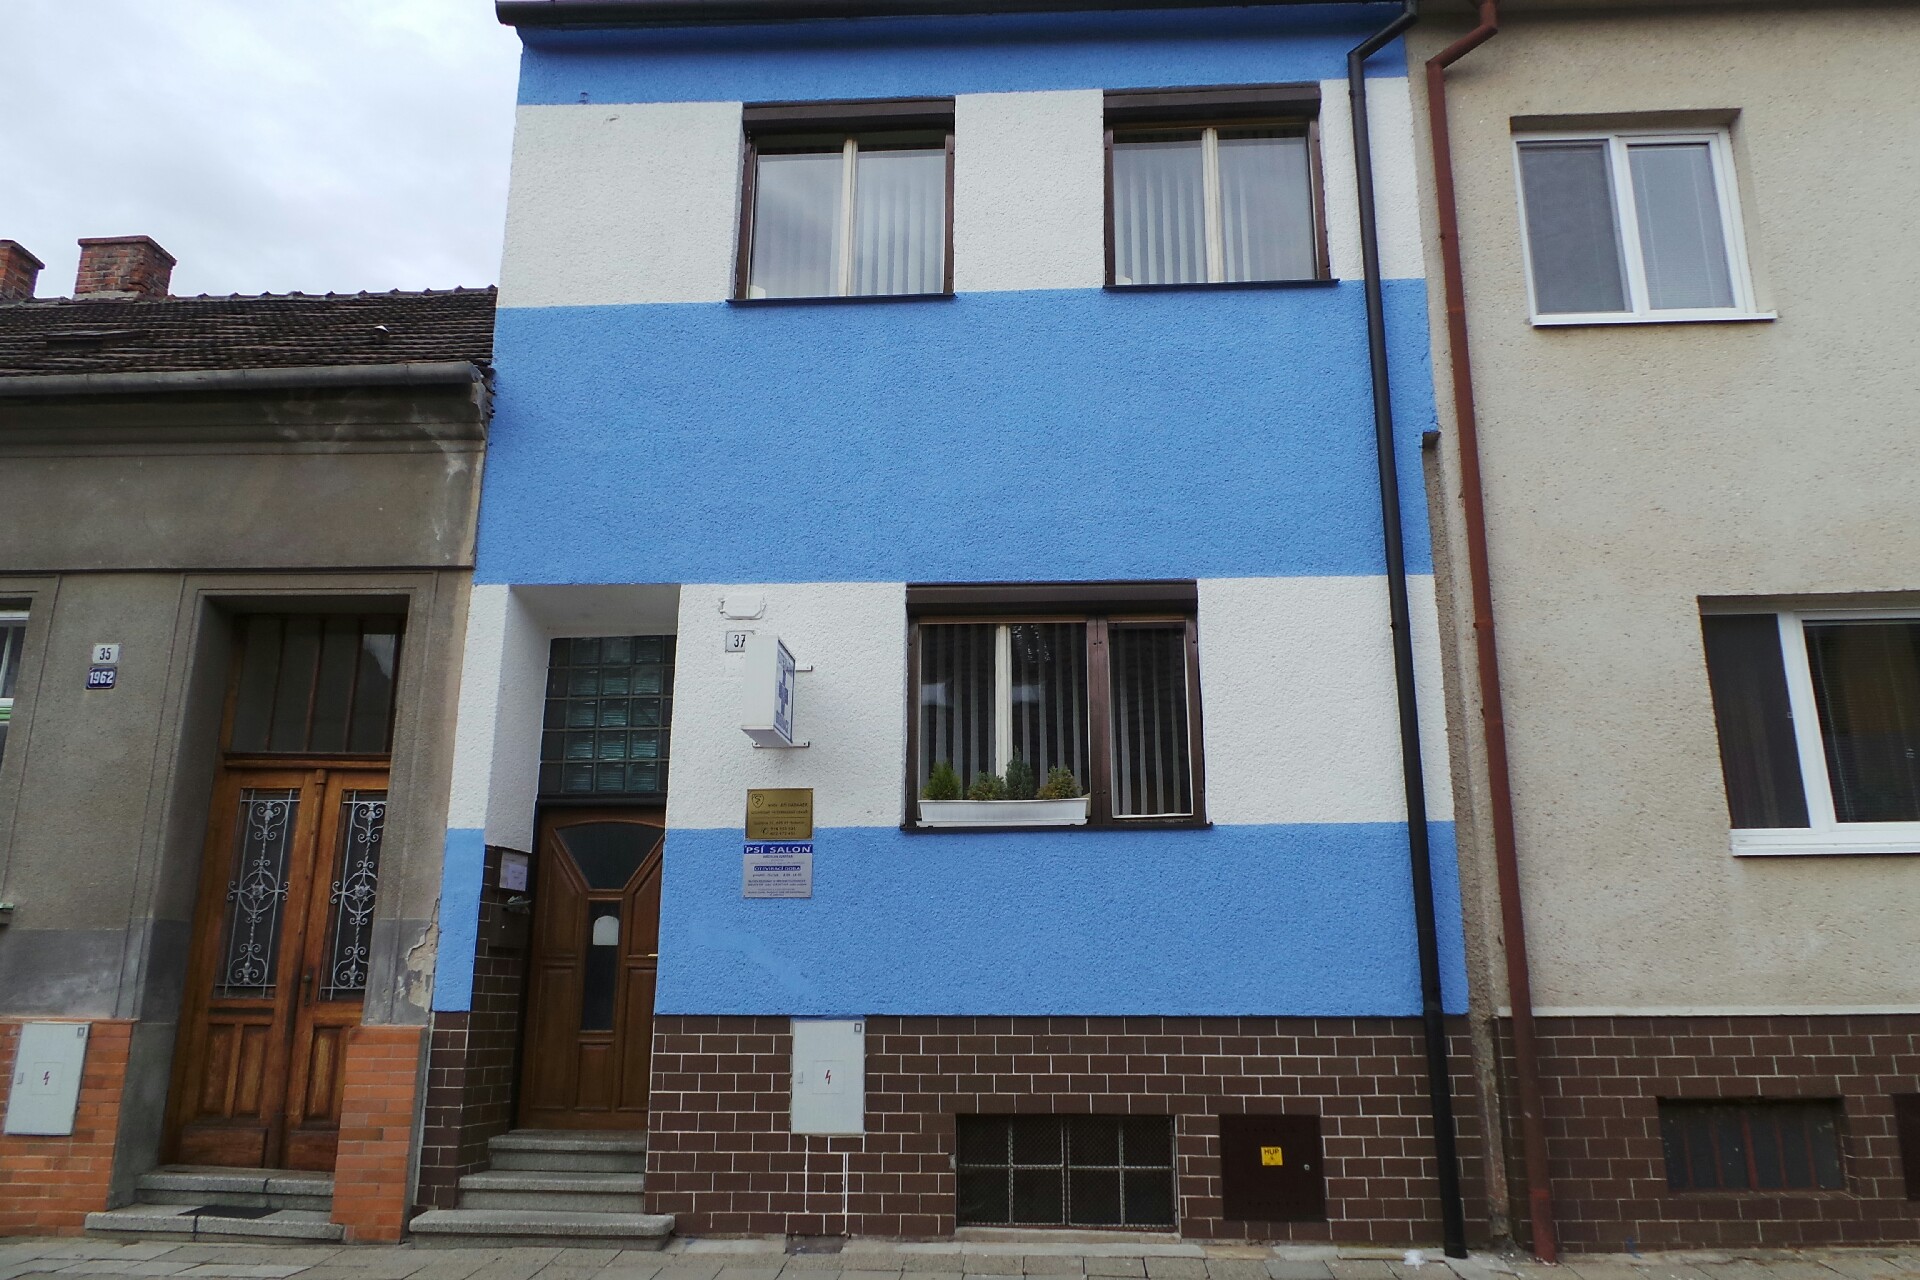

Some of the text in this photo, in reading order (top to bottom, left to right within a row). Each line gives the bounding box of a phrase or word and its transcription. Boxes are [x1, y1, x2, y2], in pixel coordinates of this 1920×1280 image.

[734, 635, 746, 648] 37
[100, 647, 111, 660] 35
[90, 671, 114, 684] 1962
[746, 845, 765, 854] PSÍ
